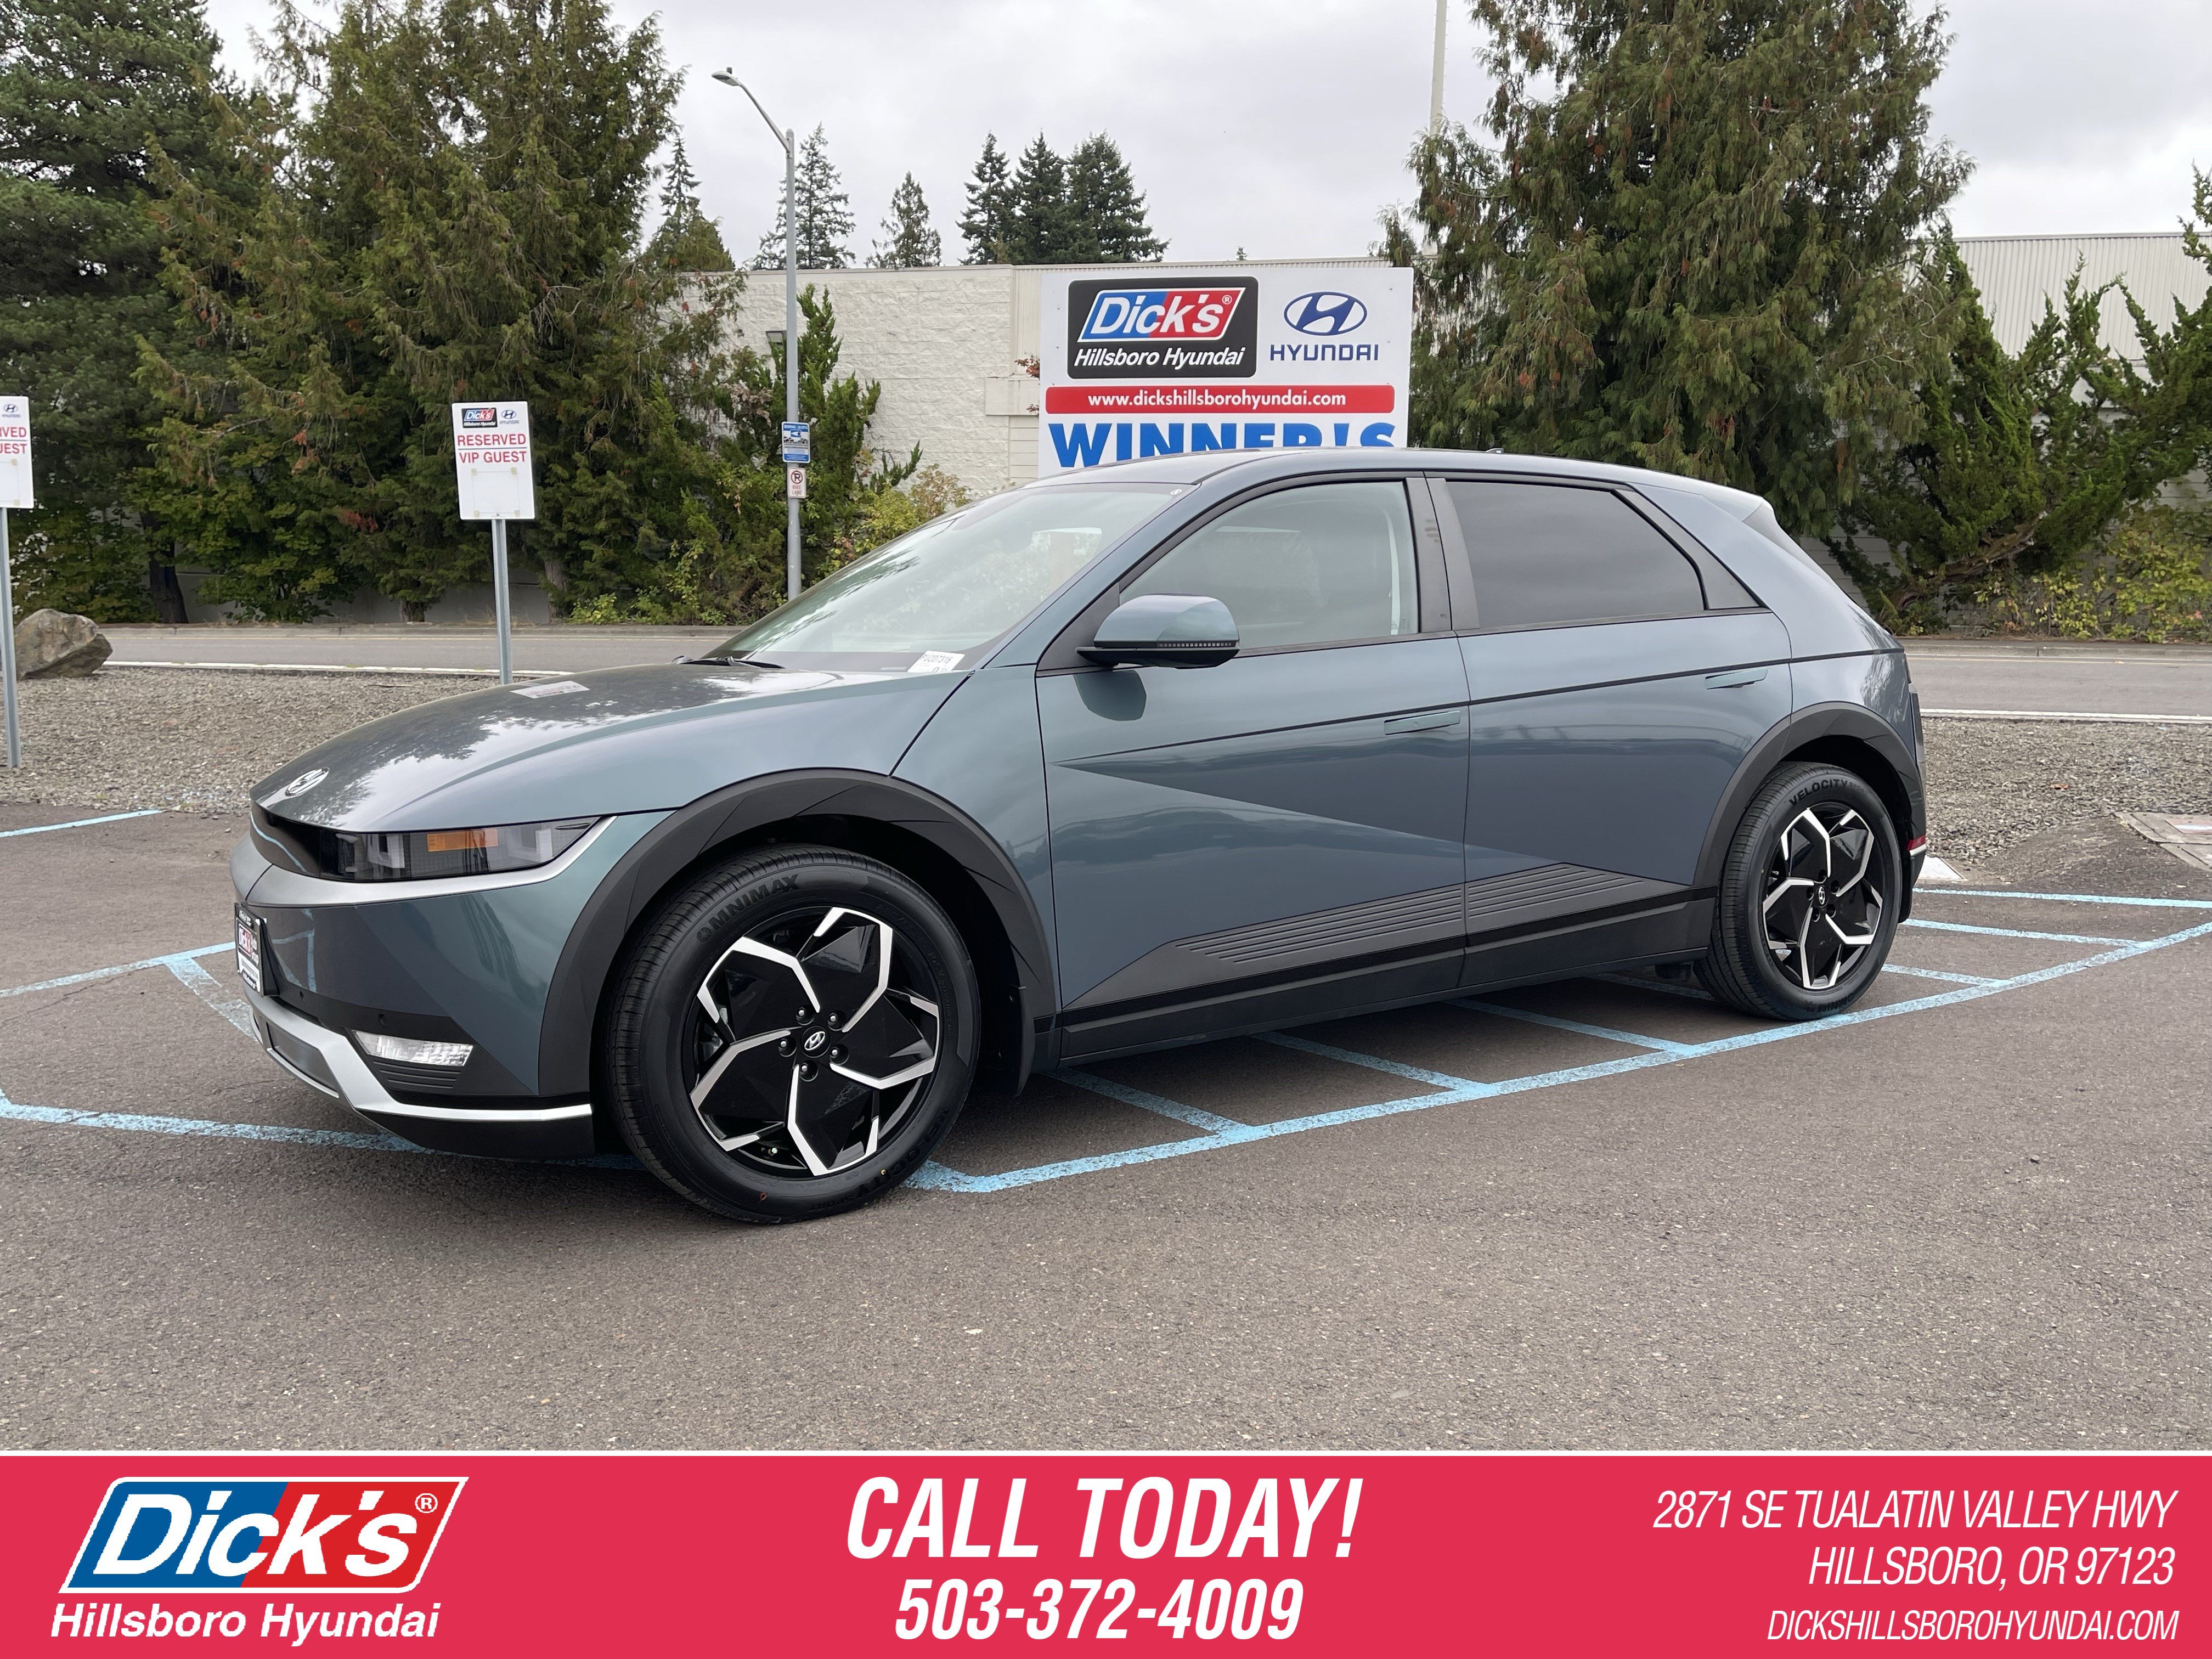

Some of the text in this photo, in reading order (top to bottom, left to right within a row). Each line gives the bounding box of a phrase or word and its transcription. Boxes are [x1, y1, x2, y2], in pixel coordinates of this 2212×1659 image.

[1090, 294, 1224, 334] Dick's
[1074, 347, 1246, 370] Hillsboro Hyundai
[1270, 344, 1379, 361] HYUNDAI
[1087, 388, 1346, 410] www.dickshillsborohyundai.com
[458, 433, 526, 446] RESERVED
[459, 451, 527, 464] VIP GUEST
[1789, 779, 1848, 806] VELOCITY
[697, 874, 800, 943] OMNIMAX
